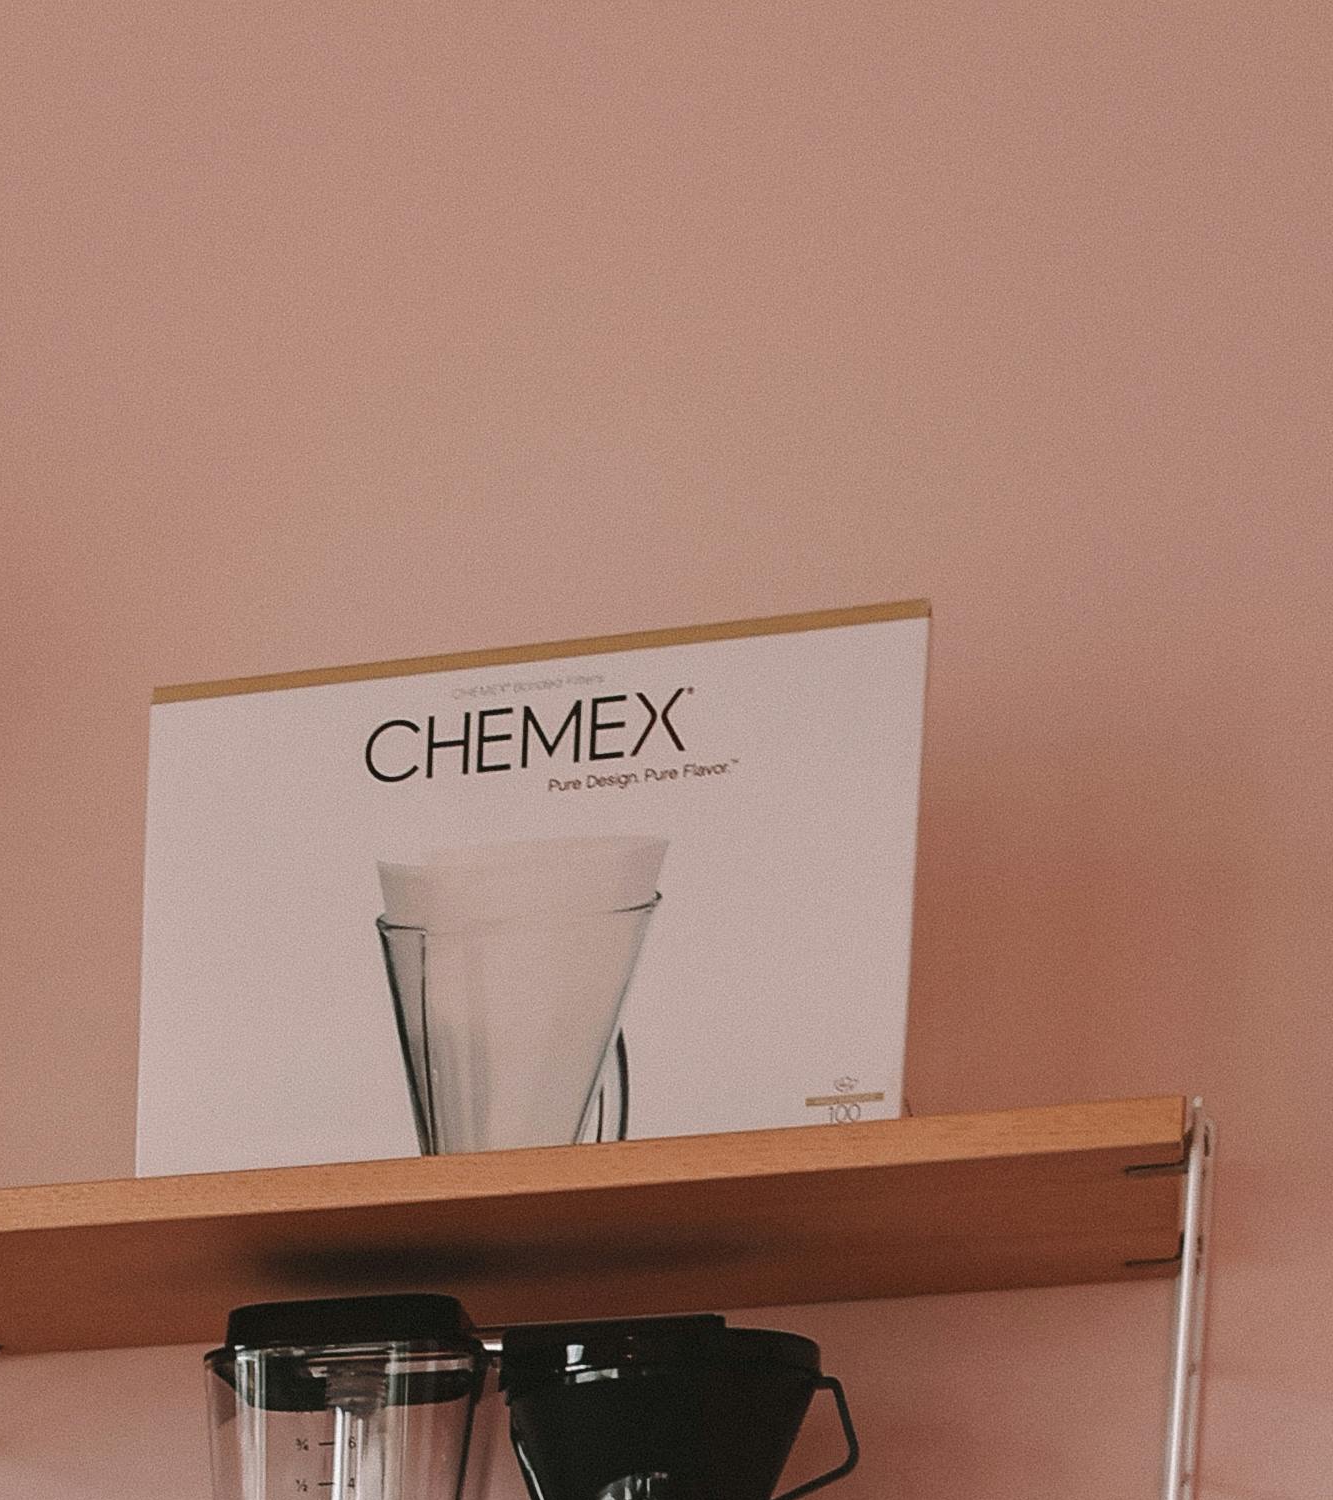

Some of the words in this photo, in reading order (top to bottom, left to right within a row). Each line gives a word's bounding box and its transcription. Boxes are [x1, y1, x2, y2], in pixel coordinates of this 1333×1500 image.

[365, 687, 686, 783] CHEMEX
[547, 776, 582, 792] Pure
[643, 767, 678, 783] Pure
